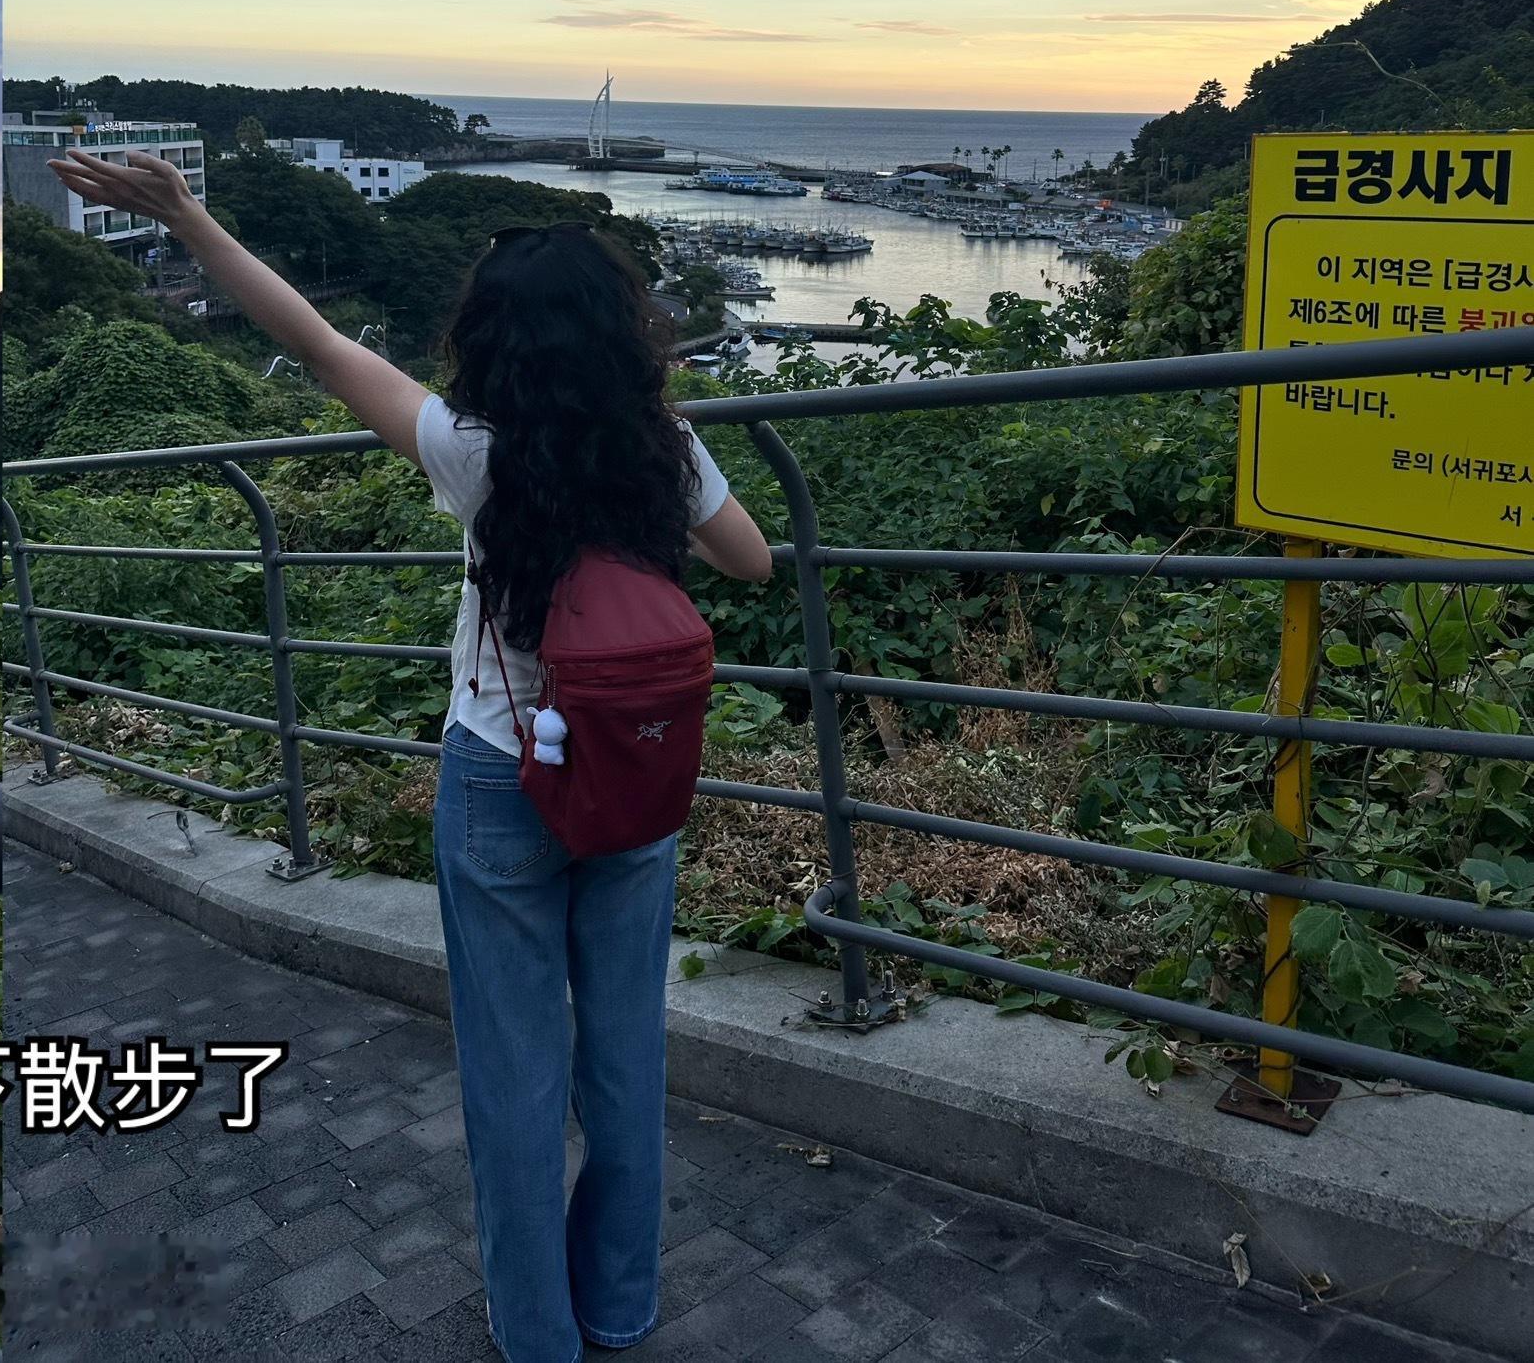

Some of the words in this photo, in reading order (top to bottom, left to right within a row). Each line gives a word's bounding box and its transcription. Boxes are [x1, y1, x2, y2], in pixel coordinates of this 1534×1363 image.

[1294, 149, 1513, 206] 급경사지
[1316, 255, 1341, 283] 이
[1351, 256, 1434, 288] 지역은
[1288, 297, 1381, 330] 제6조에
[1392, 304, 1448, 334] 따른
[1457, 307, 1534, 333] 붕괴
[1285, 382, 1396, 420] 바랍니다.
[1391, 448, 1434, 475] 문의
[1500, 504, 1523, 528] 서
